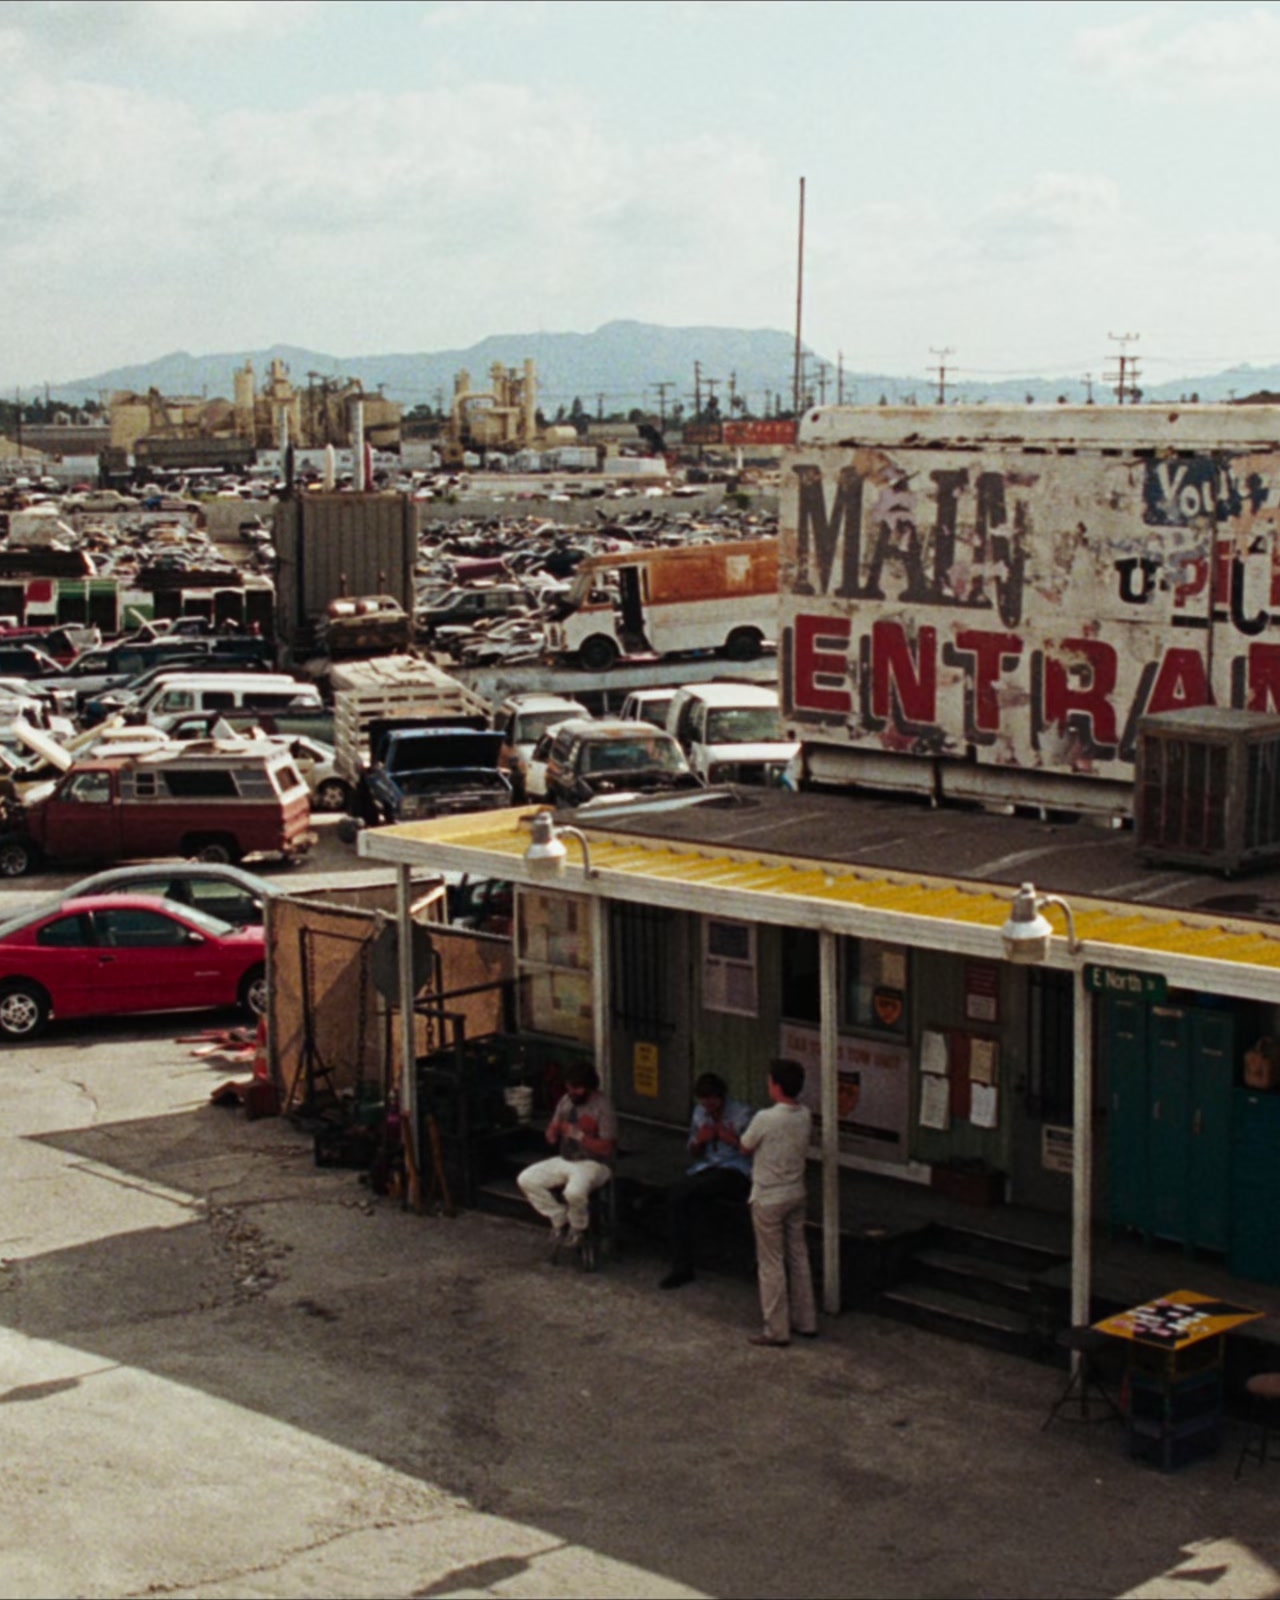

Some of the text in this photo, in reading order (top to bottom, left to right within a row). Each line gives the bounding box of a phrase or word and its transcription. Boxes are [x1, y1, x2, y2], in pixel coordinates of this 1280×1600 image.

[791, 463, 1028, 628] MAIN
[1092, 966, 1102, 988] E
[1105, 969, 1142, 993] North
